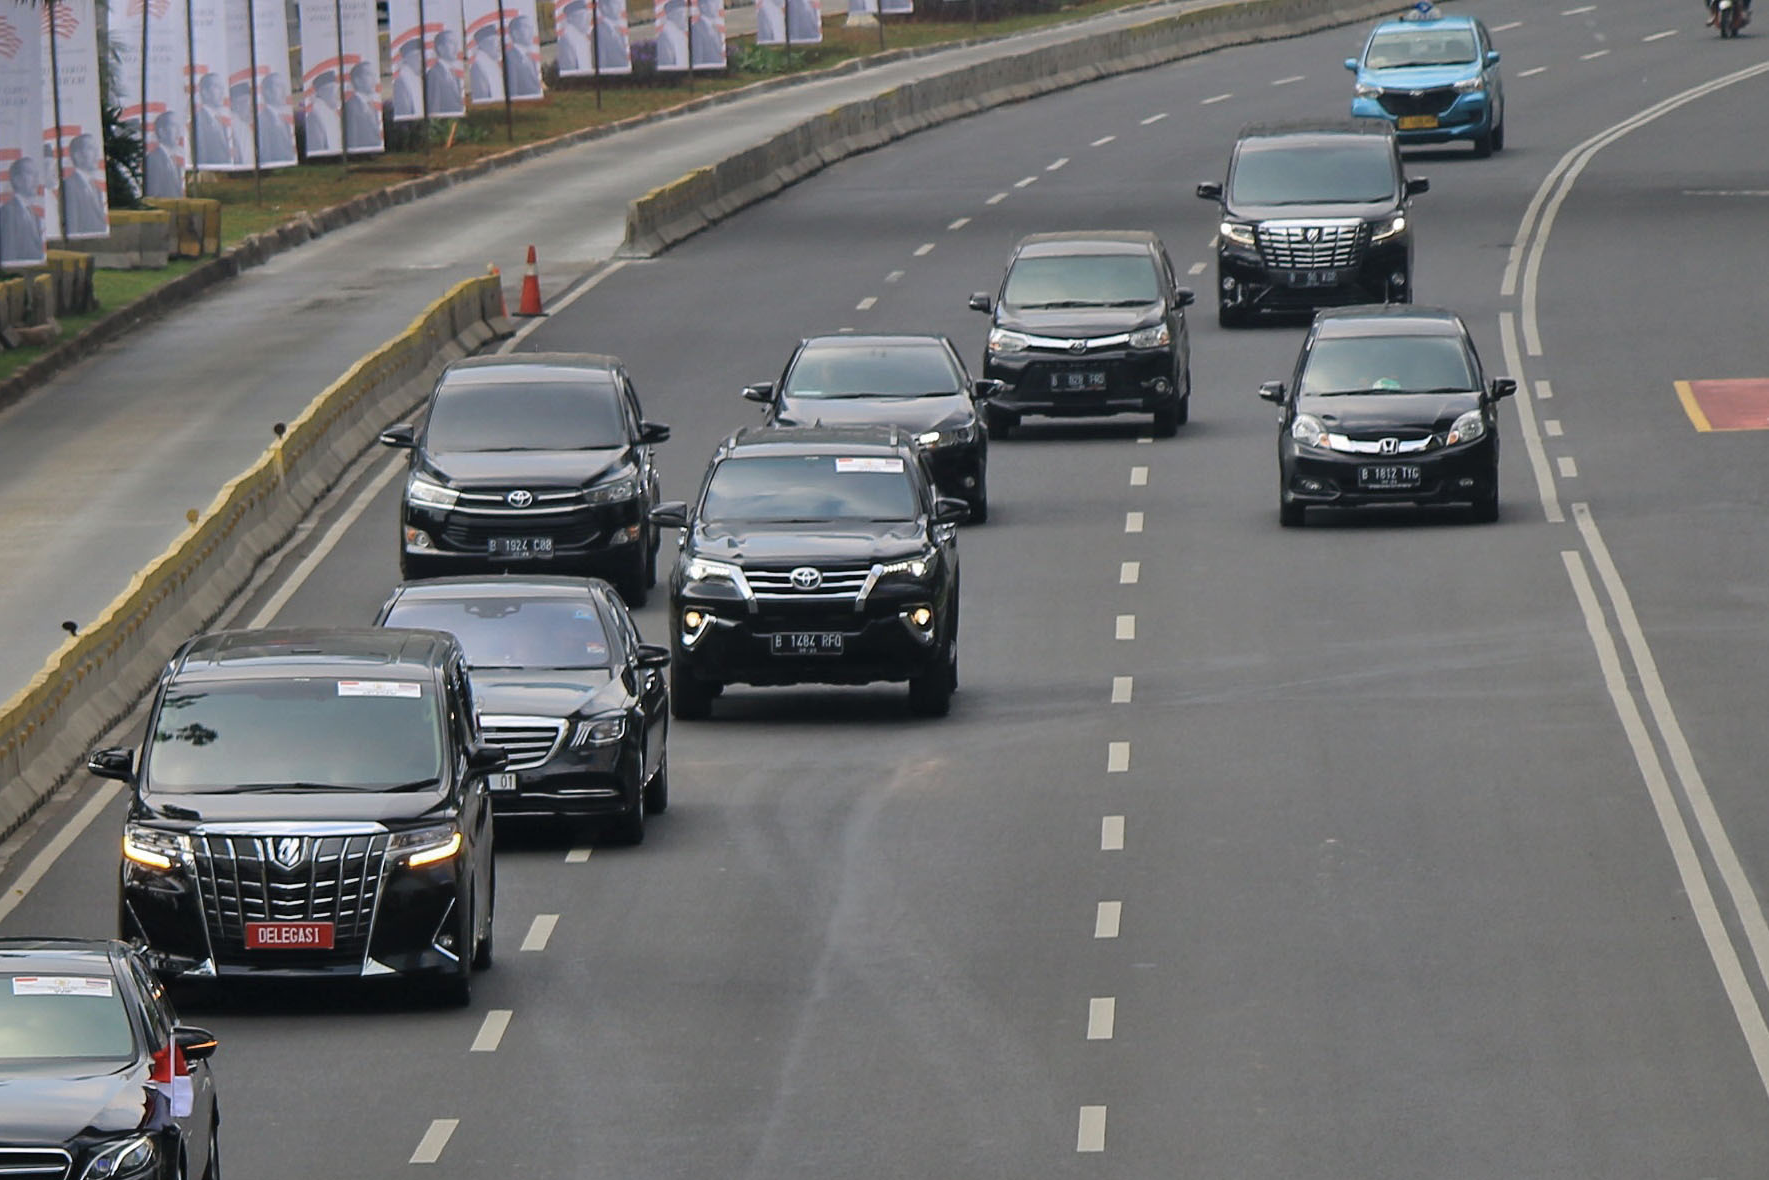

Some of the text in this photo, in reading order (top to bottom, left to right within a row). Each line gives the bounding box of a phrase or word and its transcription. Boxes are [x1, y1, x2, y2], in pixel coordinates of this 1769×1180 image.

[1362, 467, 1368, 480] B
[775, 634, 782, 647] B
[258, 927, 320, 943] DELEGASI
